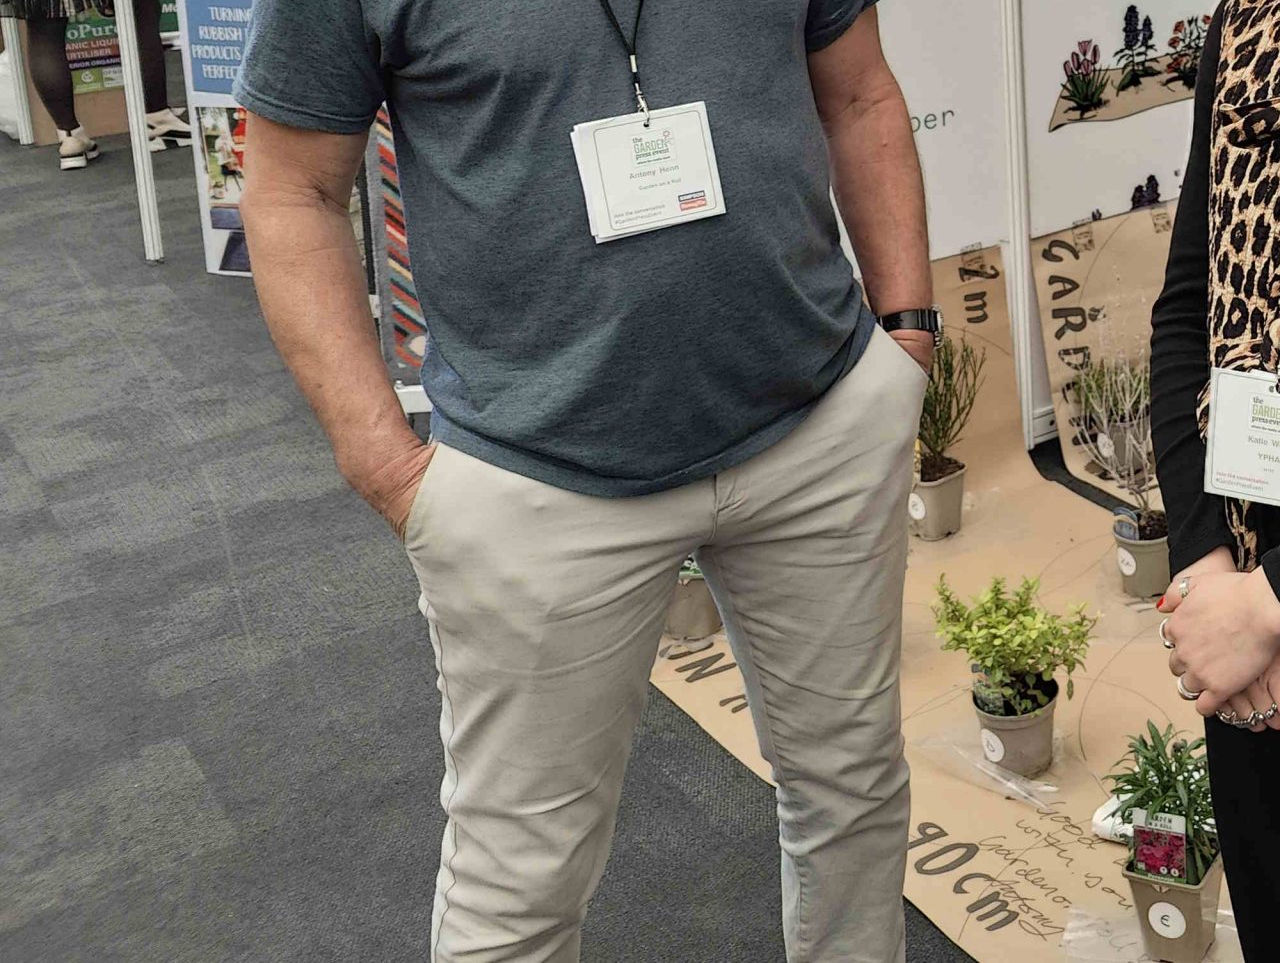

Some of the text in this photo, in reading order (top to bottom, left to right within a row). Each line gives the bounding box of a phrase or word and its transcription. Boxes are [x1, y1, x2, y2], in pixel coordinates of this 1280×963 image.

[199, 26, 242, 41] RUBBISH
[191, 44, 241, 60] PRODUCTS
[1253, 396, 1264, 404] the
[1248, 436, 1268, 446] Katie
[1258, 453, 1280, 464] YPHA
[1151, 813, 1173, 823] ARDEN
